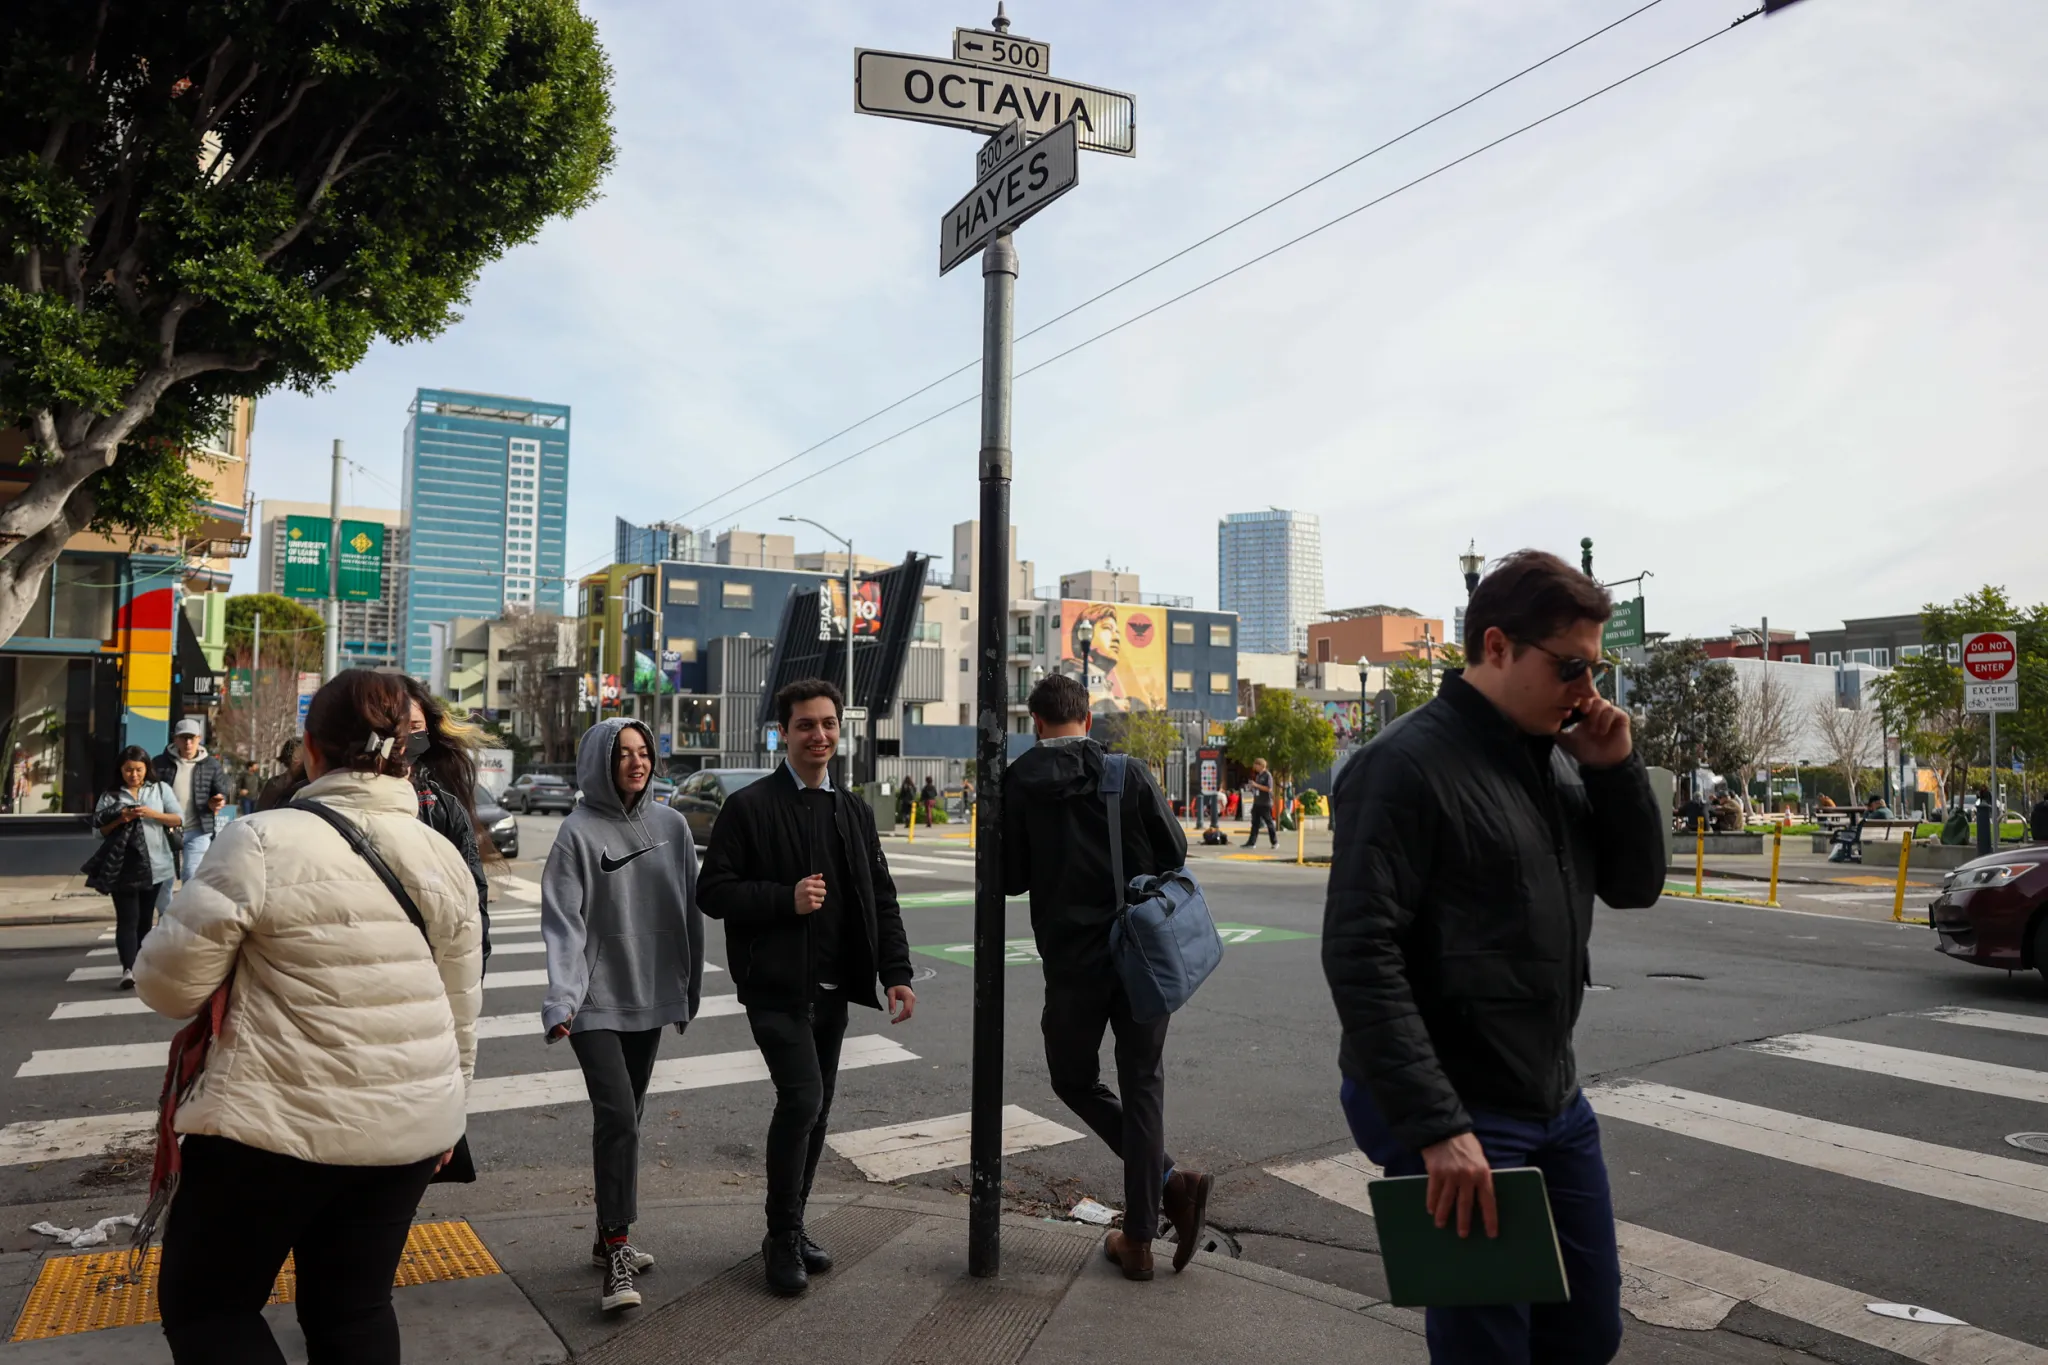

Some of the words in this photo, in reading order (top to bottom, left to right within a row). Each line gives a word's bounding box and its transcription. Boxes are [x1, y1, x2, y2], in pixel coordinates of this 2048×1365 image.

[992, 40, 1040, 68] 500
[904, 69, 1094, 132] OCTAVIA
[980, 139, 1002, 175] 500
[955, 151, 1049, 247] HAYES
[288, 540, 328, 549] UNIVERSITY
[820, 585, 832, 641] SFJAZZ
[1971, 643, 1984, 651] DO
[1989, 641, 2007, 650] NOT
[1975, 663, 2004, 672] ENTER
[1972, 686, 2008, 695] EXCEPT
